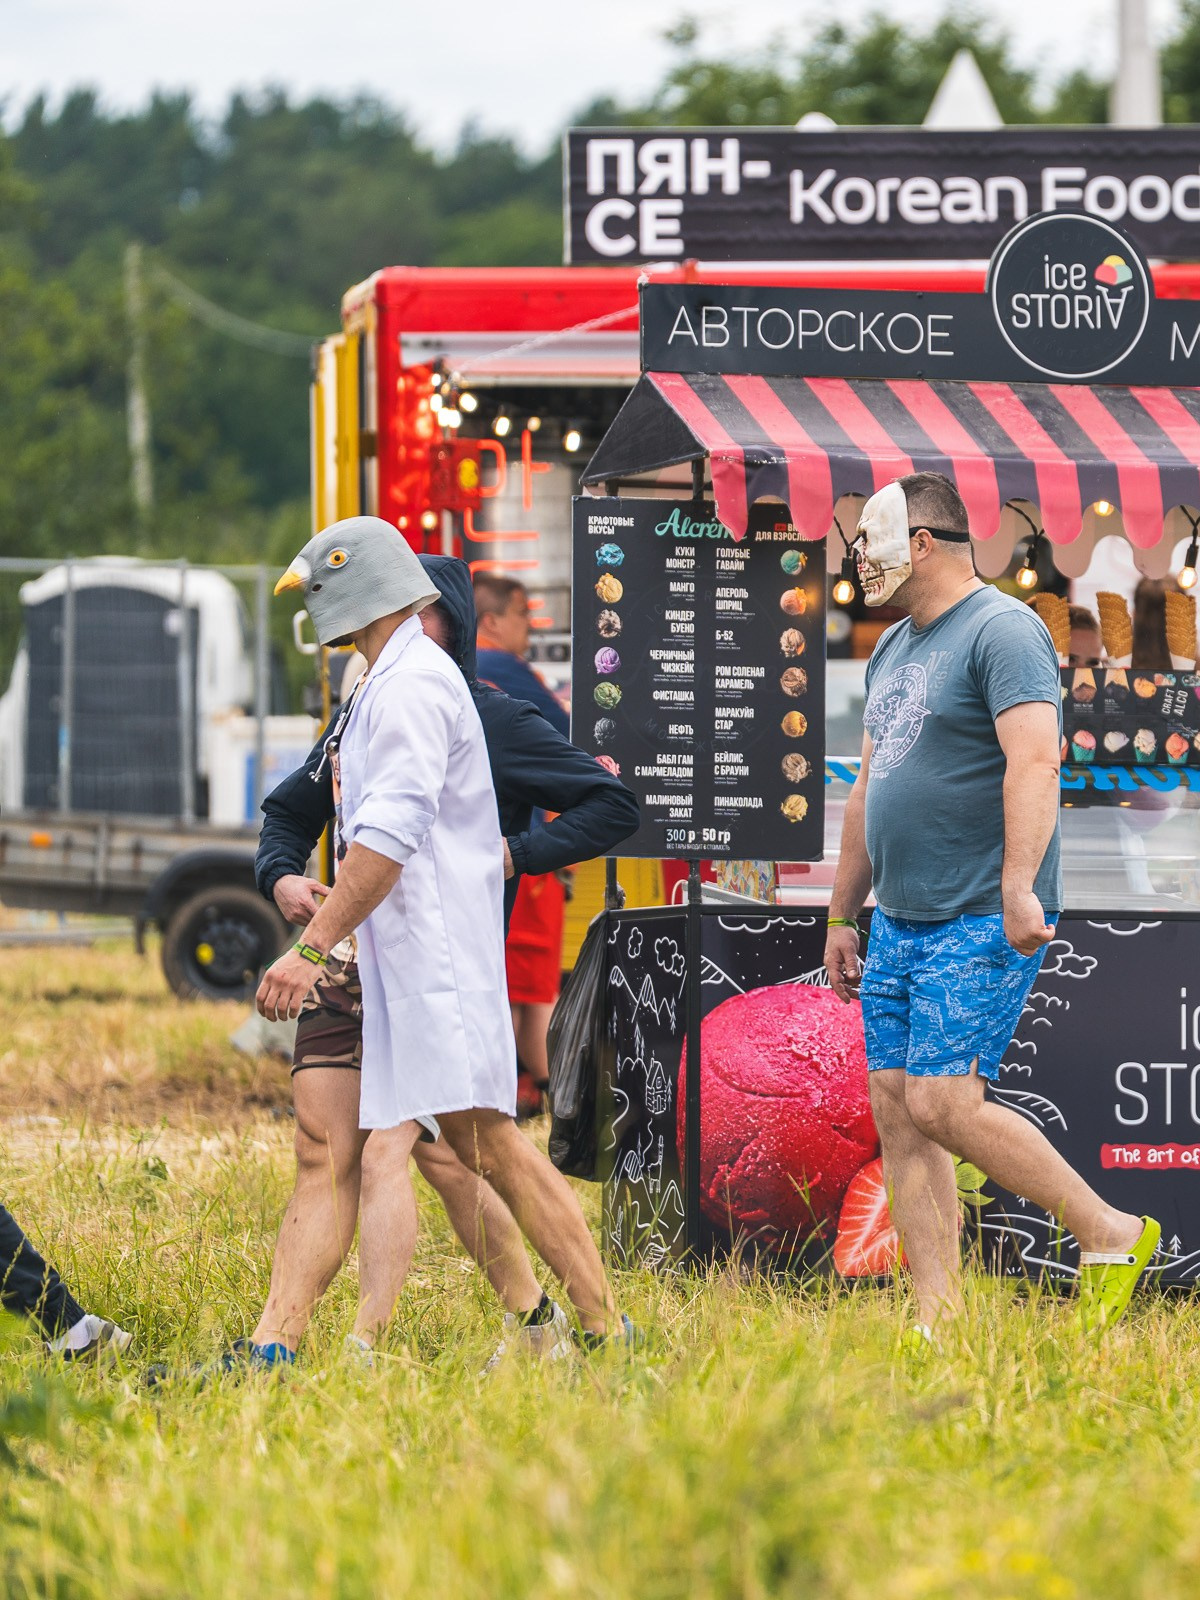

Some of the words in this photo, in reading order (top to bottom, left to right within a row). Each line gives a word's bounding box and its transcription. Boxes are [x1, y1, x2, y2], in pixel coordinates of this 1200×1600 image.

[587, 138, 771, 196] ПЯН-
[789, 168, 1027, 223] Korean
[585, 198, 685, 257] СЕ
[1043, 254, 1087, 291] ice
[1011, 284, 1134, 330] STORIA
[667, 305, 955, 357] АВТОРСКОЕ
[588, 516, 635, 527] КРАФТОВЫЕ
[588, 525, 615, 535] ВКУСЫ
[755, 531, 772, 542] ДЛЯ
[675, 546, 695, 557] КУКИ
[716, 548, 751, 559] ГОЛУБЫЕ
[666, 558, 695, 569] МОНСТР
[716, 559, 745, 571] ГАВАЙИ
[669, 582, 695, 592] МАНГО
[716, 587, 749, 599] АПЕРОЛЬ
[716, 600, 743, 612] ШПРИЦ
[665, 610, 695, 621] КИНДЕР
[671, 623, 695, 634] БУЕНО
[715, 629, 734, 641] Б-52
[650, 649, 695, 661] ЧЕРНИЧНЫЙ
[661, 661, 695, 674] ЧИЗКЕЙК
[715, 666, 732, 676] РОМ
[733, 666, 765, 677] СОЛЕНАЯ
[715, 678, 755, 690] КАРАМЕЛЬ
[653, 690, 695, 702] ФИСТАШКА
[1161, 688, 1176, 716] CRAFT
[1173, 689, 1189, 717] ALCO
[715, 706, 755, 718] МАРАКУЙЯ
[669, 724, 694, 735] НЕФТЬ
[715, 720, 734, 731] СТАР
[657, 754, 675, 765] БАБЛ
[677, 754, 694, 765] ГАМ
[715, 751, 744, 763] БЕЙЛИС
[635, 767, 641, 777] С
[641, 767, 694, 778] МАРМЕЛАДОМ
[715, 765, 720, 776] С
[721, 765, 749, 776] БРАУНИ
[646, 794, 693, 806] МАЛИНОВЫЙ
[714, 796, 763, 809] ПИНАКОЛАДА
[669, 807, 693, 818] ЗАКАТ
[666, 829, 686, 842] 300
[688, 830, 696, 844] р
[703, 828, 717, 841] 50
[718, 831, 731, 845] гр
[1112, 1147, 1141, 1164] The
[1147, 1147, 1175, 1164] art
[1181, 1148, 1200, 1165] of
